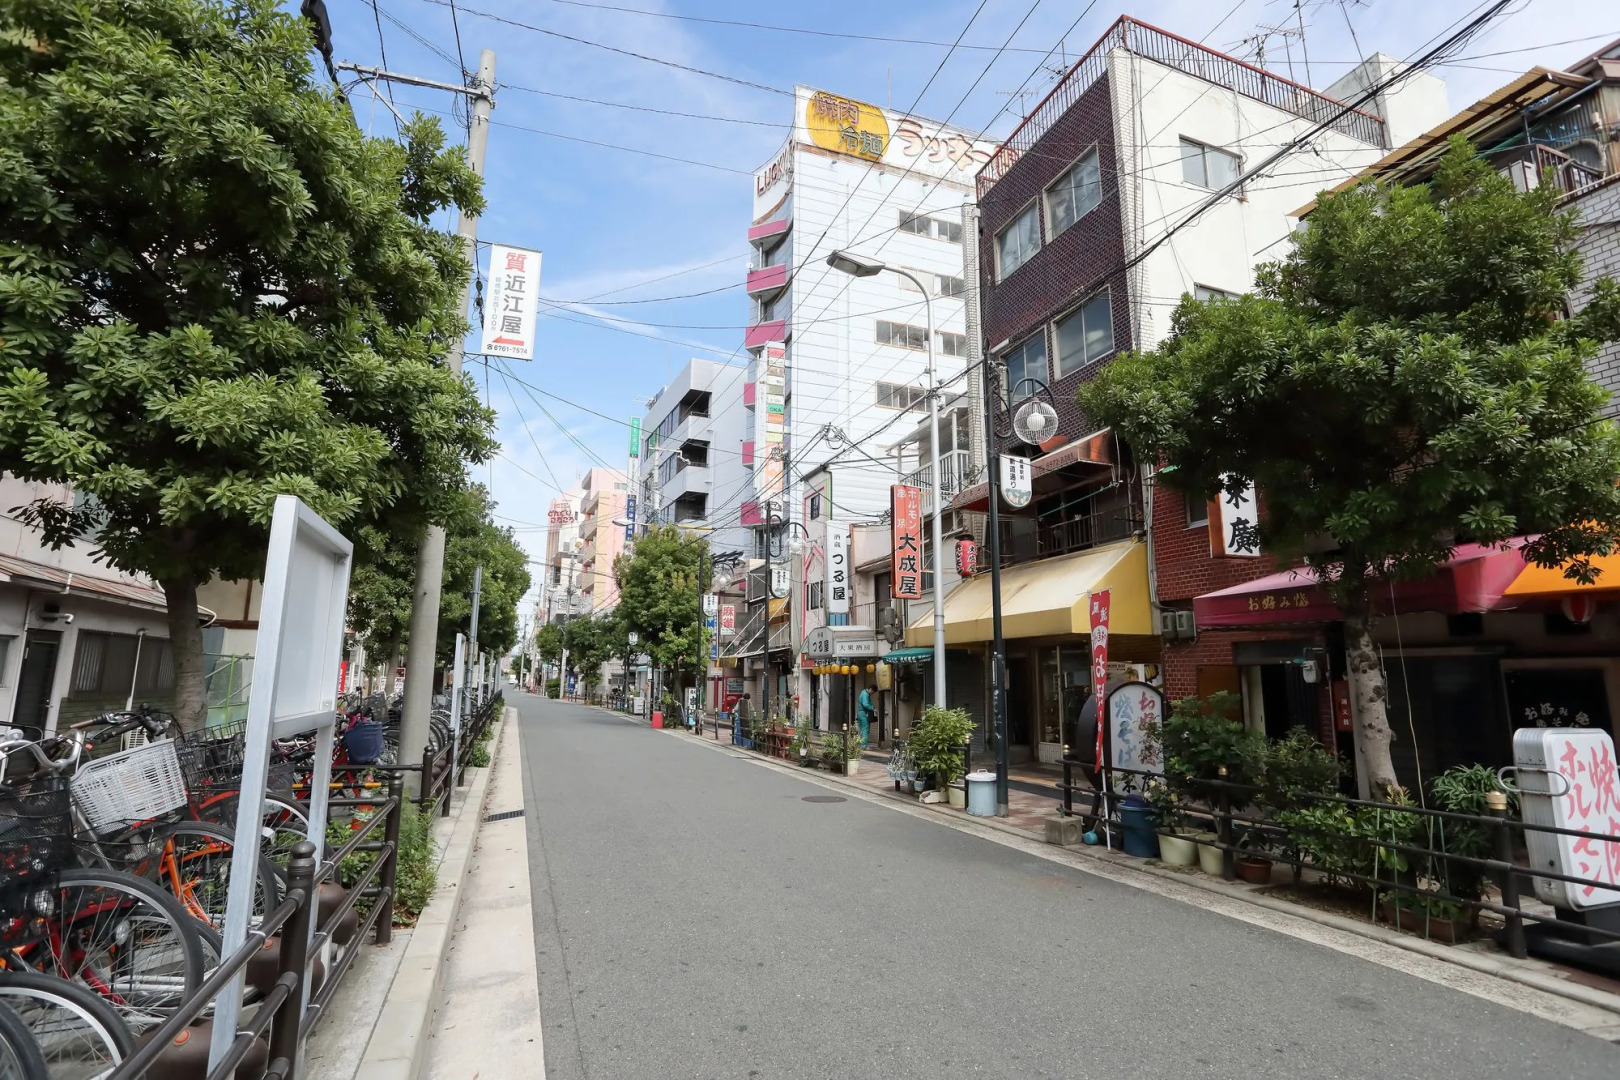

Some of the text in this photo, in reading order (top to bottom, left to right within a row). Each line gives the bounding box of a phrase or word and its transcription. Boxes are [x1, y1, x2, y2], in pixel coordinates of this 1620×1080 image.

[505, 252, 527, 273] 質
[500, 274, 526, 335] 近江屋
[907, 489, 918, 529] ホルモン
[832, 553, 846, 601] つる屋
[898, 533, 918, 596] 大成屋
[1560, 740, 1602, 898] ホルモン
